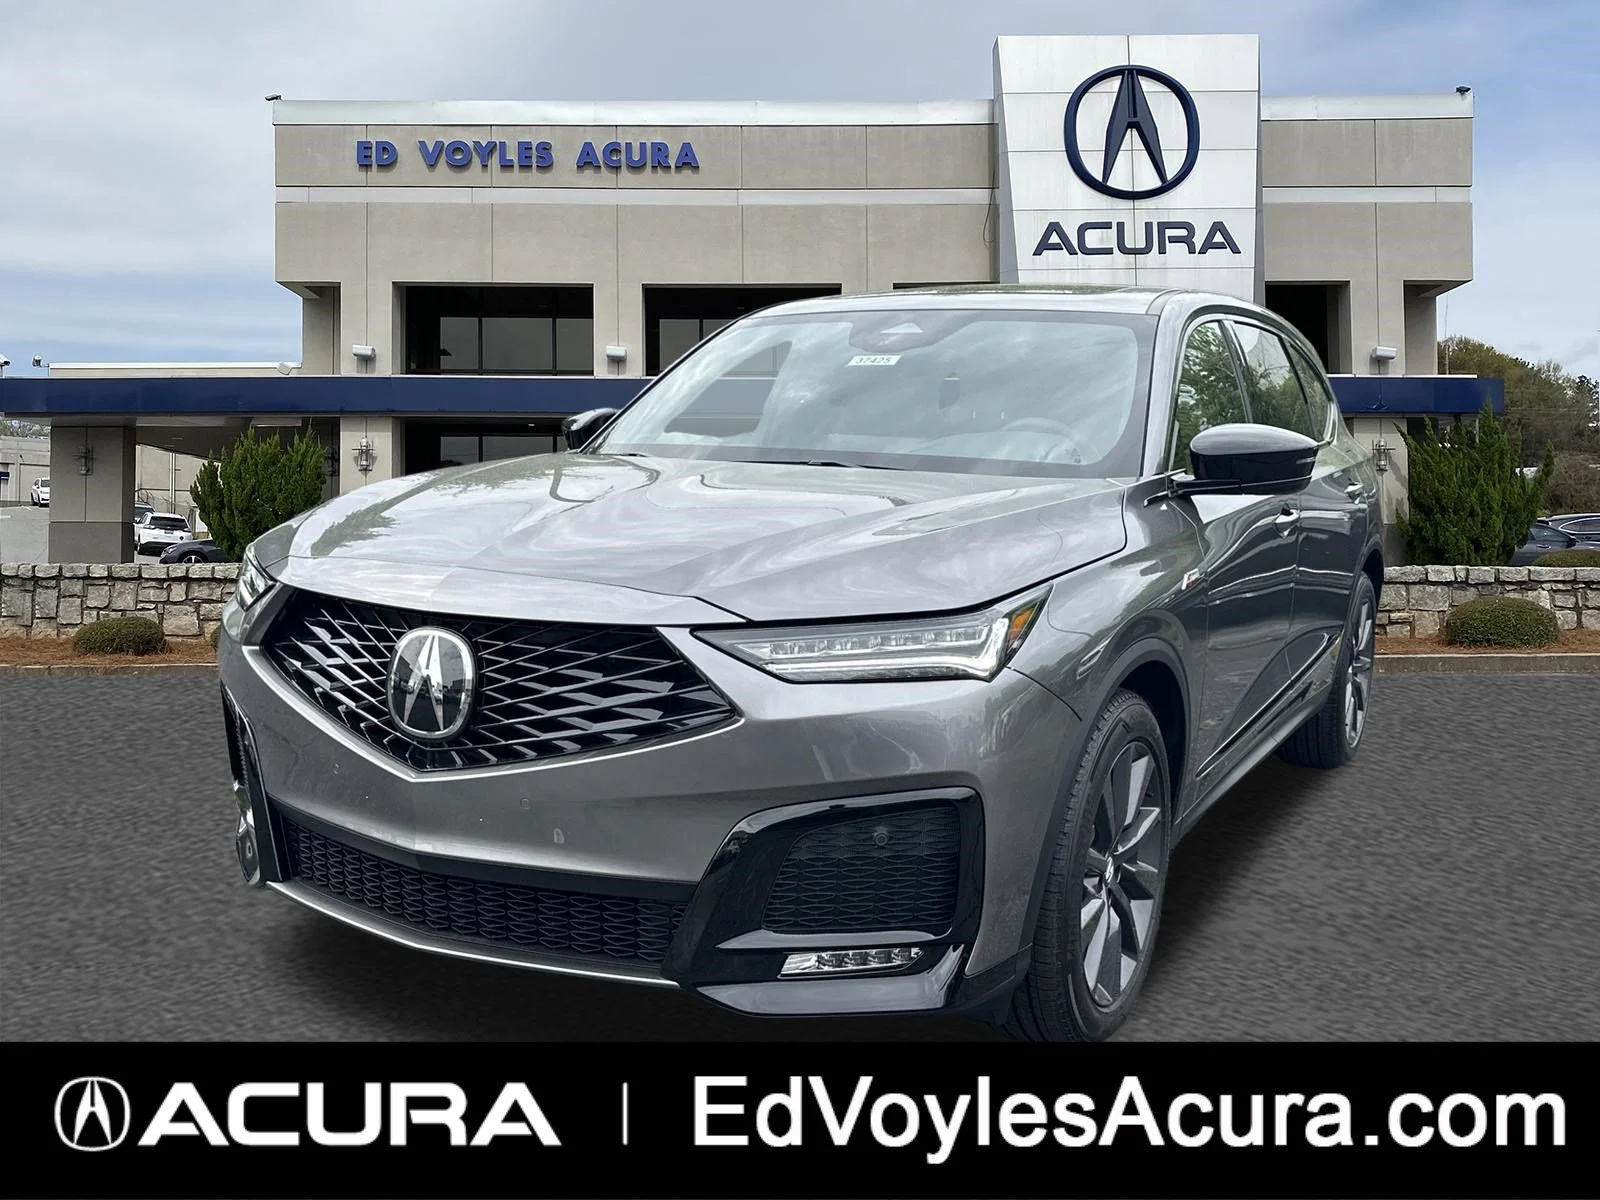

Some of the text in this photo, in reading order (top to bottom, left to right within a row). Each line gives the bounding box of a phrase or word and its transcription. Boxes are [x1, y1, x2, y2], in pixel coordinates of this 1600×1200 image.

[356, 139, 700, 170] ED VOYLES ACURA
[1032, 220, 1242, 257] ACURA
